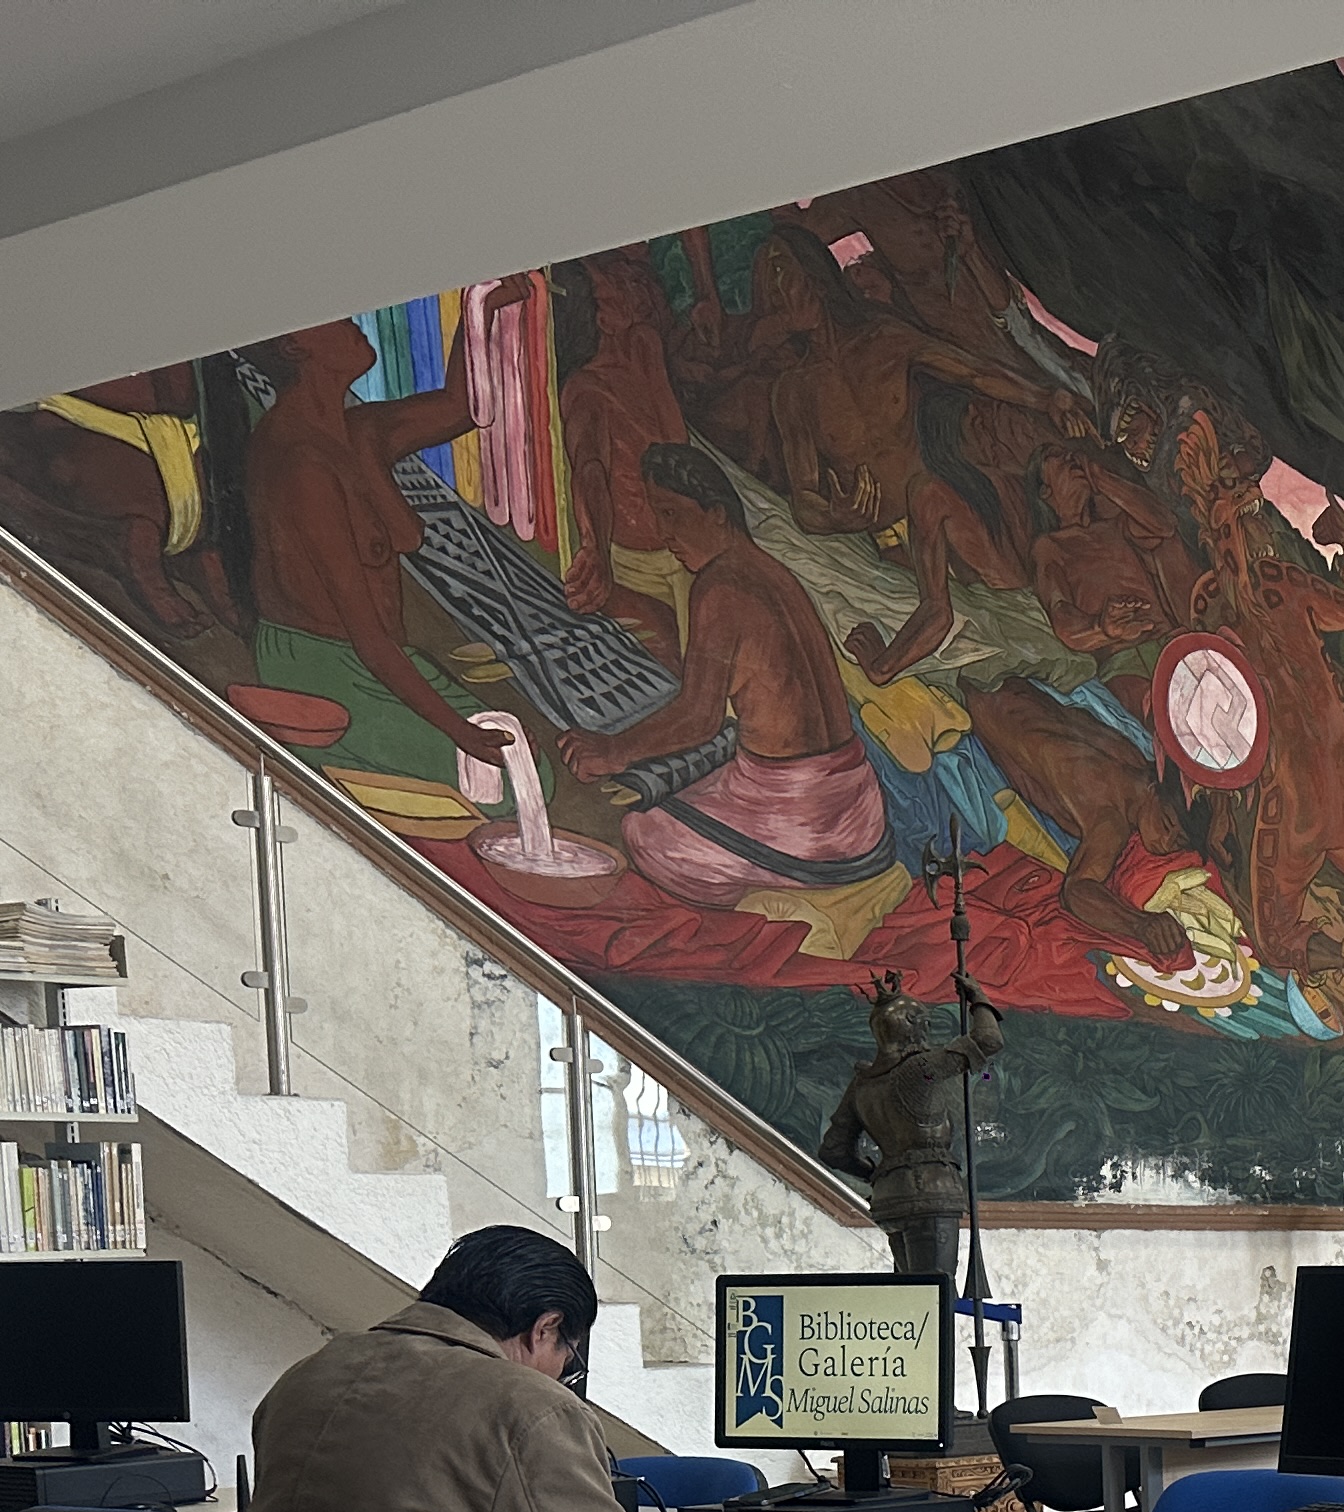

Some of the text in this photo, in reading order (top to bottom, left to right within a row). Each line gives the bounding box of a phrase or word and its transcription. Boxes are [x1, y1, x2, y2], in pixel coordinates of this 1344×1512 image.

[799, 1311, 930, 1350] Biblioteca/
[798, 1345, 908, 1377] Galería
[786, 1386, 930, 1421] Miguel Salinas
